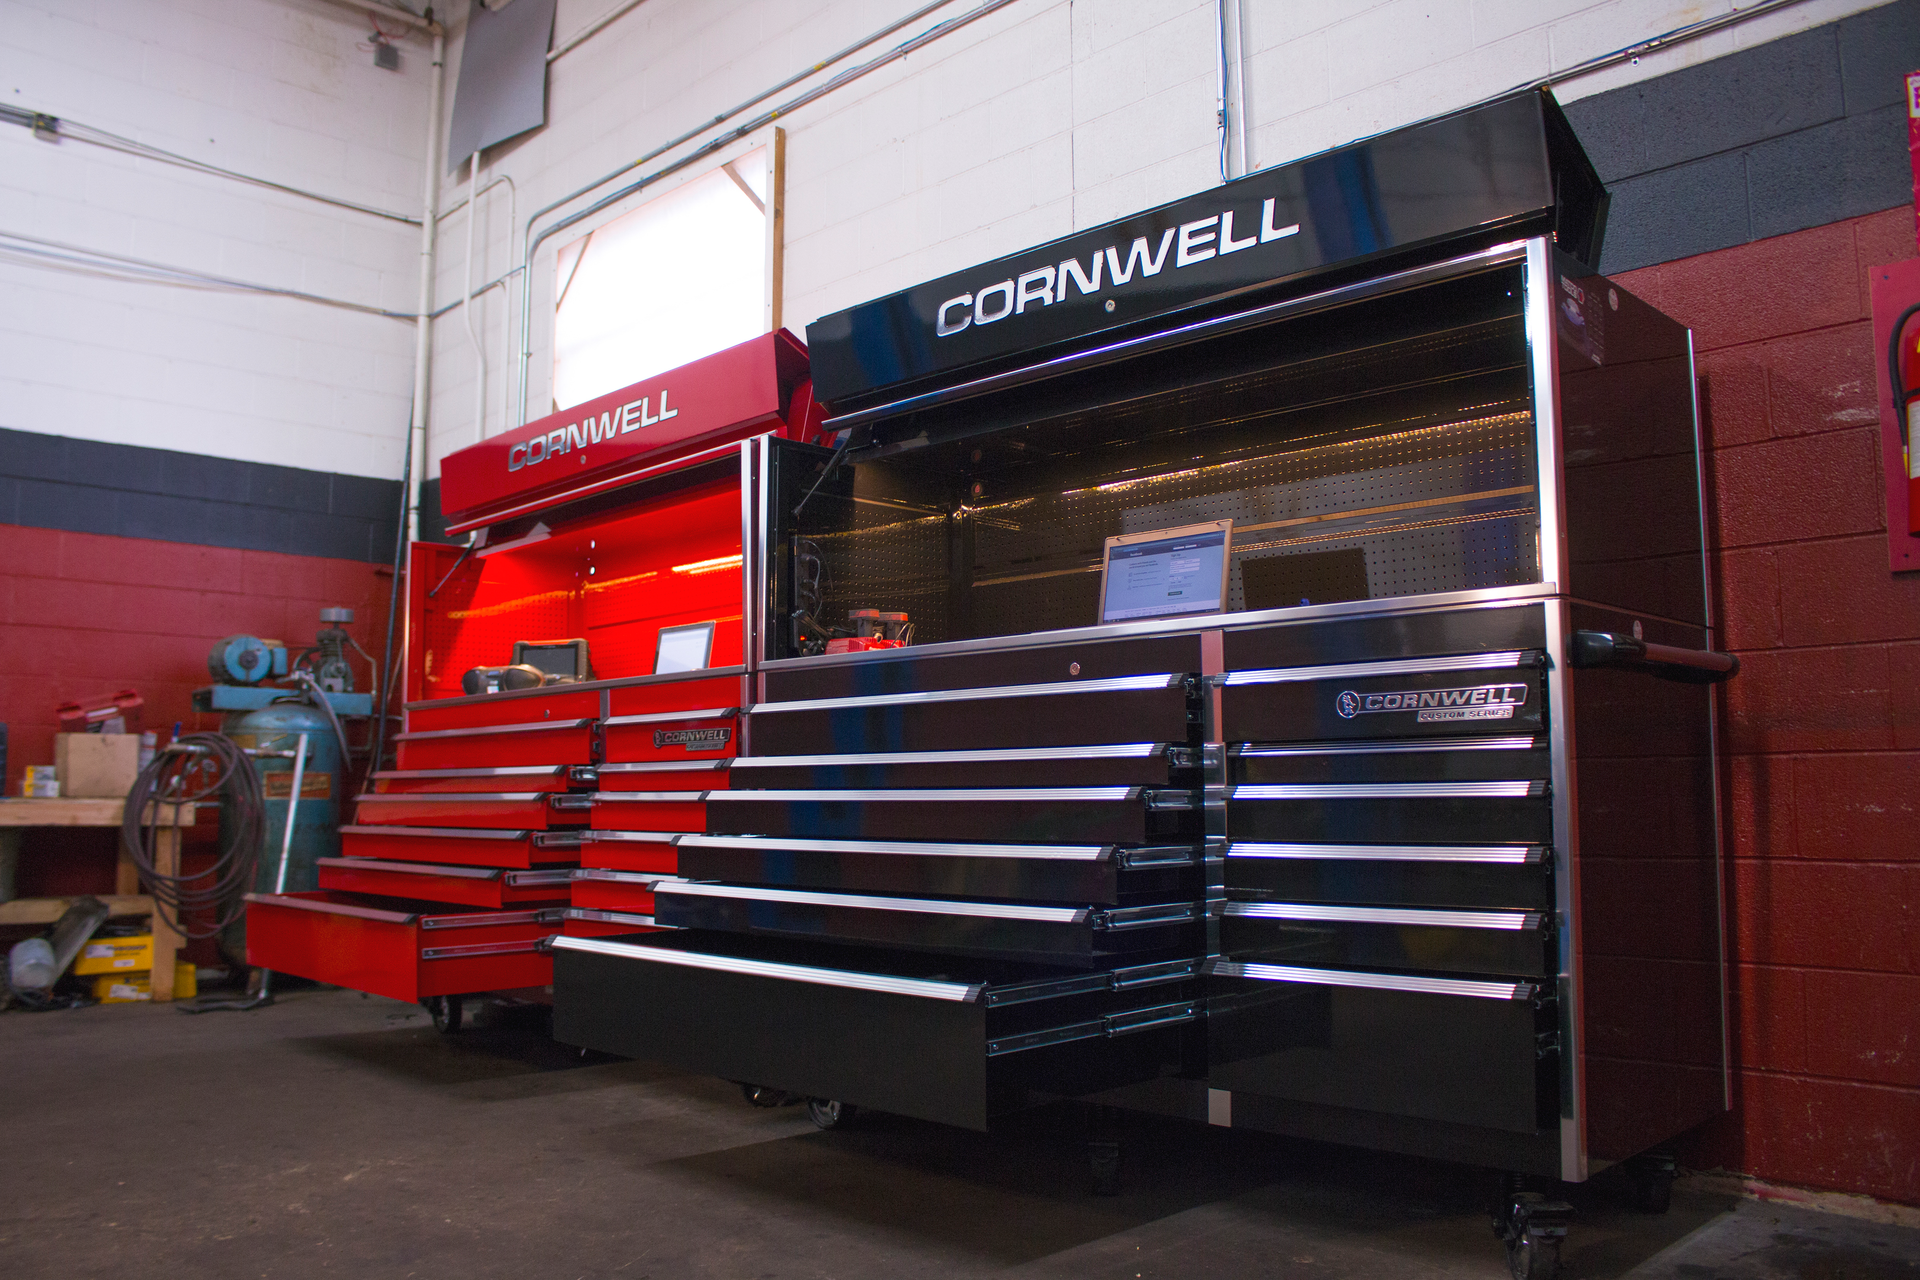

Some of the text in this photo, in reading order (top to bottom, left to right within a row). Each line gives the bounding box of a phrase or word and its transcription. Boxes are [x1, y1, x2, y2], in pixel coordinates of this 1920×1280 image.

[936, 197, 1300, 337] CORNWELL
[508, 389, 678, 472] CORNWELL
[1366, 688, 1515, 709] CORNWELL
[1420, 708, 1511, 721] CUSTOM SERIES
[664, 730, 725, 742] CORNWELL
